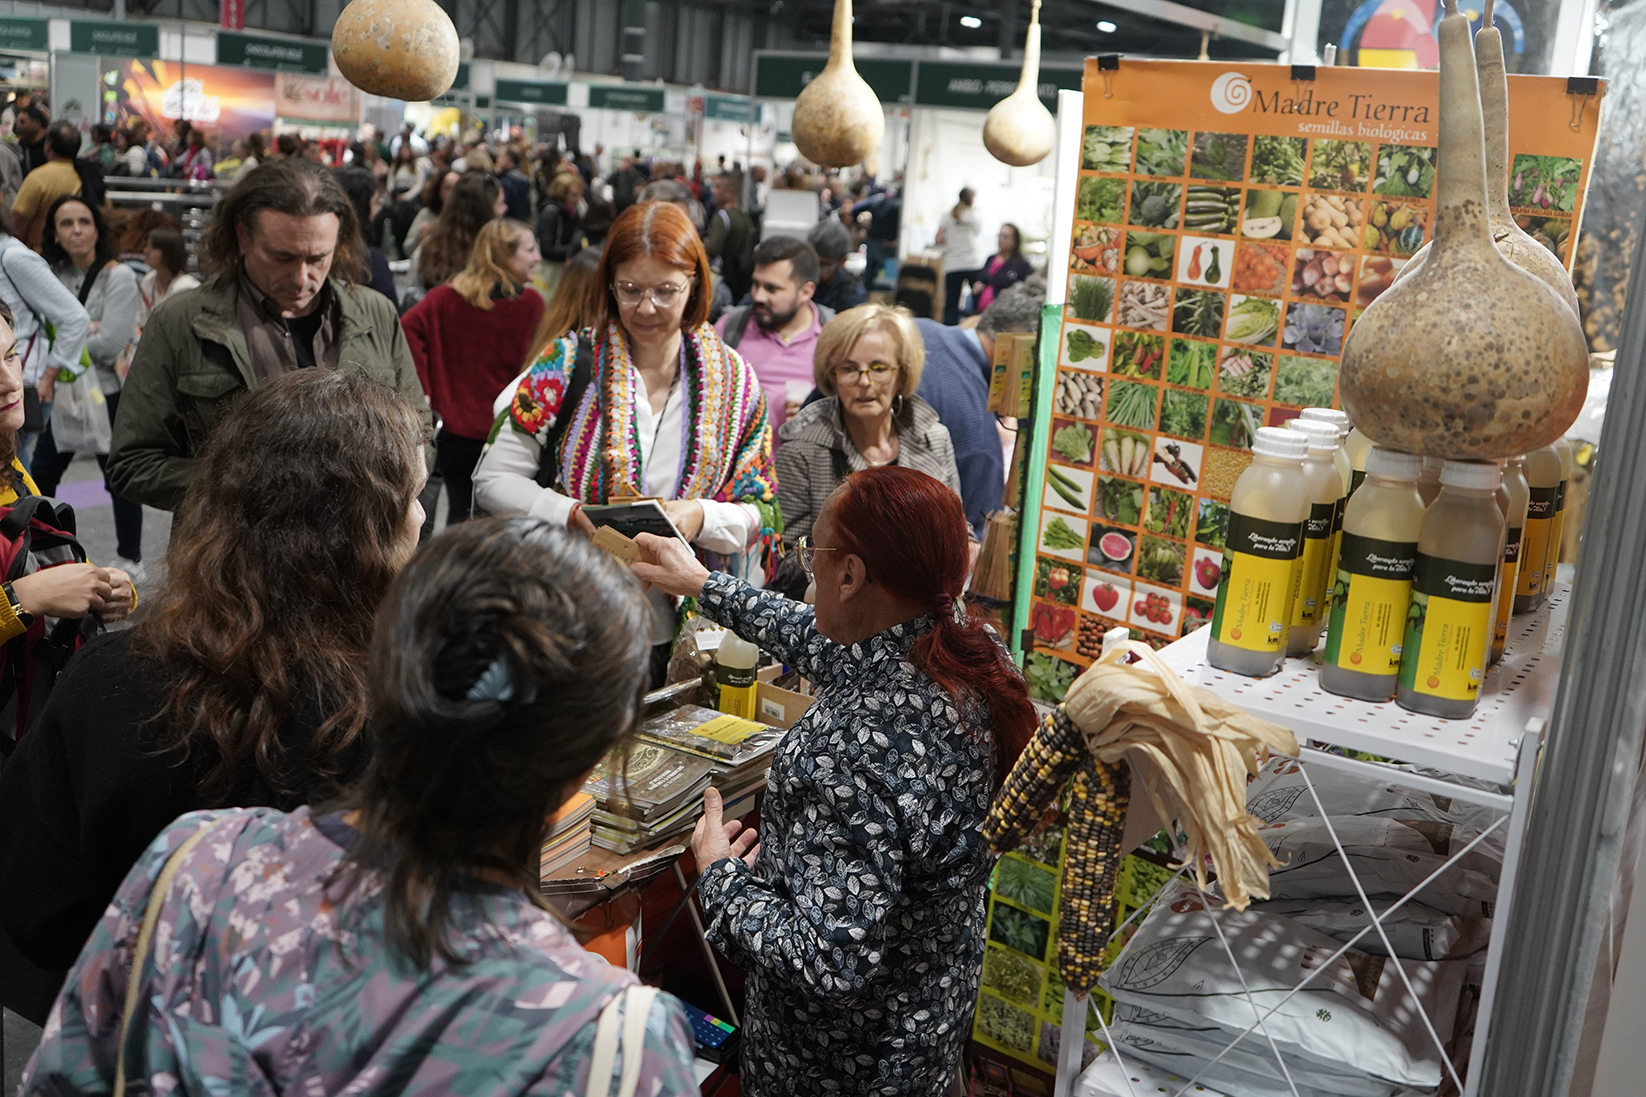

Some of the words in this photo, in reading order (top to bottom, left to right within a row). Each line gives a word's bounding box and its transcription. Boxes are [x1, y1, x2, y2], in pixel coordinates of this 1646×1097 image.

[1253, 89, 1339, 117] Madre
[1349, 94, 1431, 123] Tierra
[1298, 120, 1354, 136] semillas
[1358, 123, 1428, 144] biológicas
[1236, 603, 1247, 629] Madre
[1356, 627, 1366, 653] Madre
[1433, 649, 1444, 676] Madre
